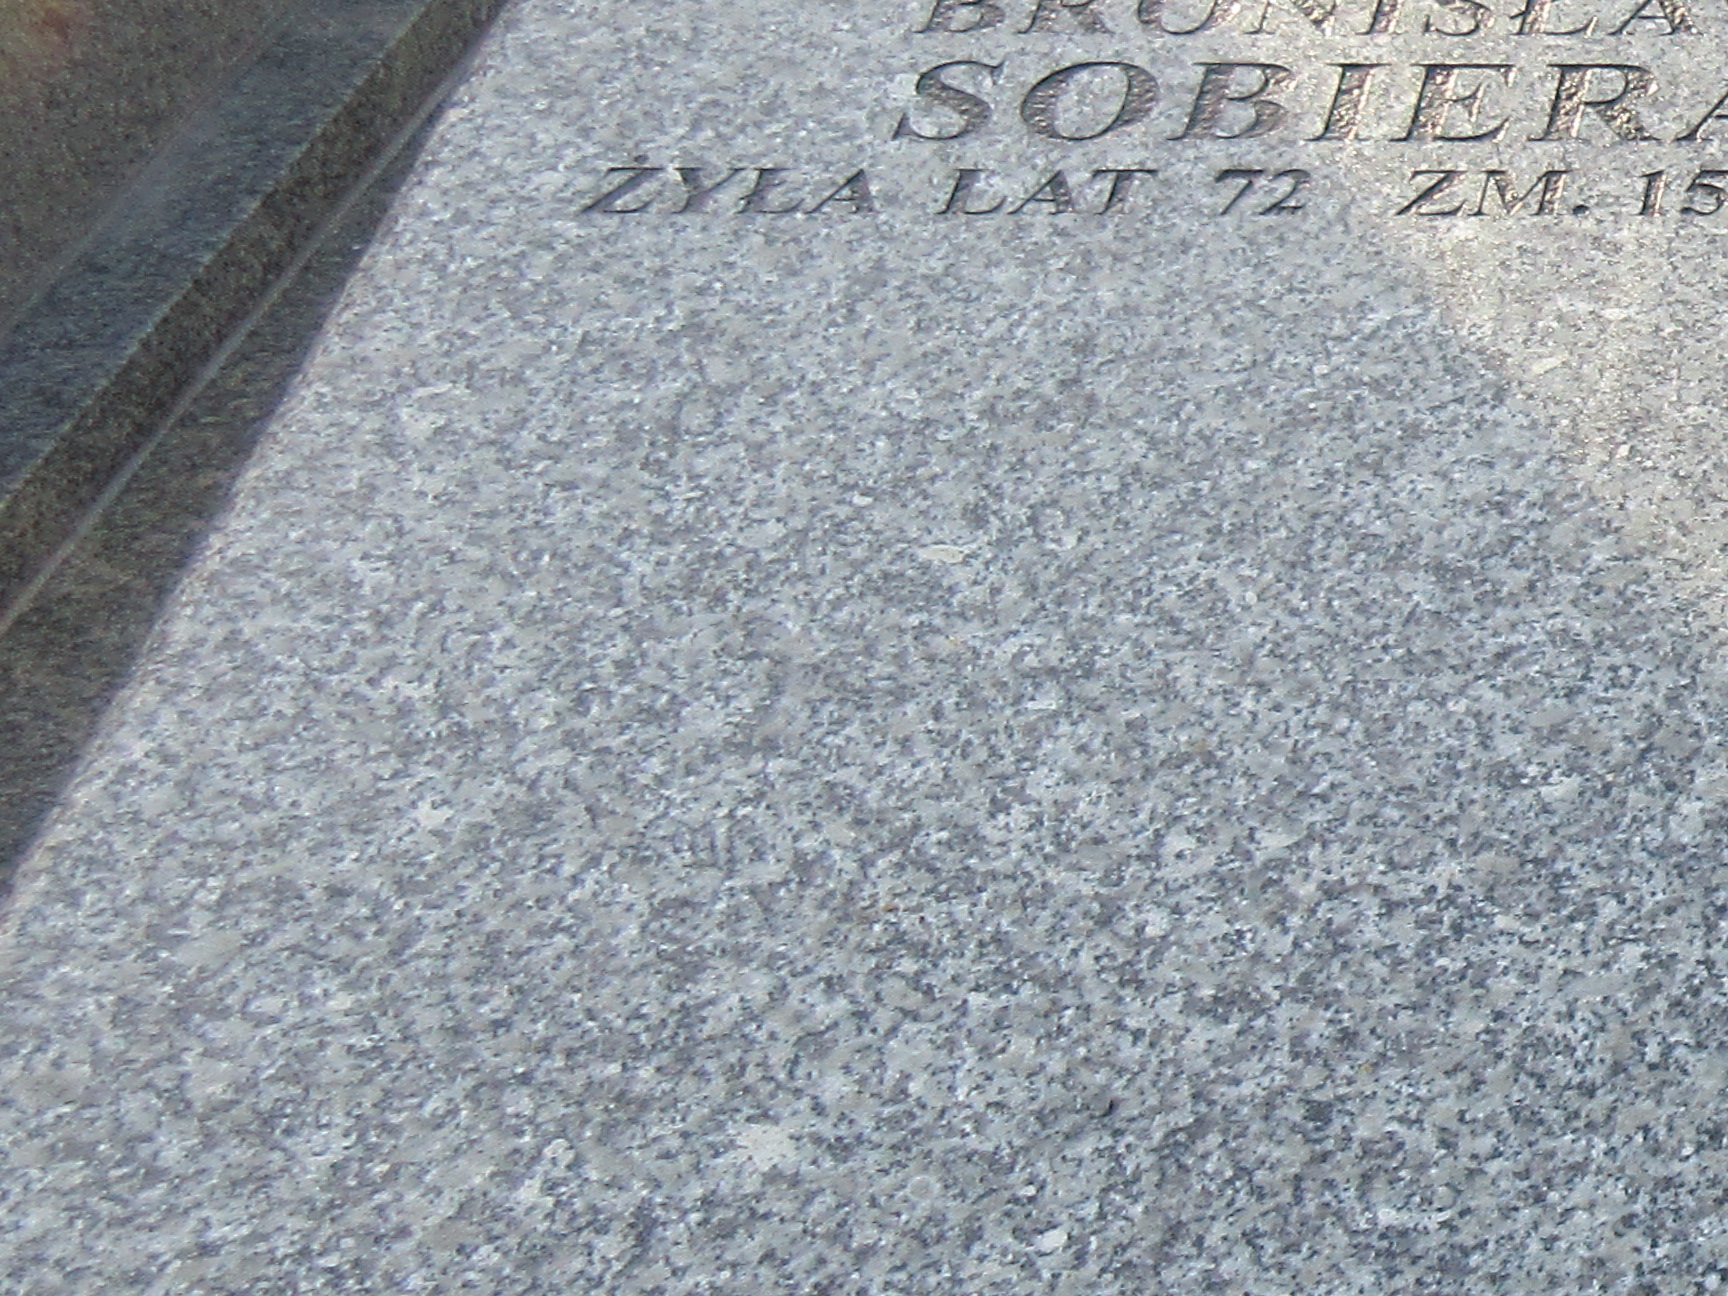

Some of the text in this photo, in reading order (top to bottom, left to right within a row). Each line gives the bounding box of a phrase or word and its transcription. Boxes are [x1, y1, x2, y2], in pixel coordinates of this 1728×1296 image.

[582, 153, 880, 216] ŻYŁA
[934, 168, 1160, 216] LAT
[1212, 168, 1313, 216] 72
[1397, 168, 1590, 218] ZM.
